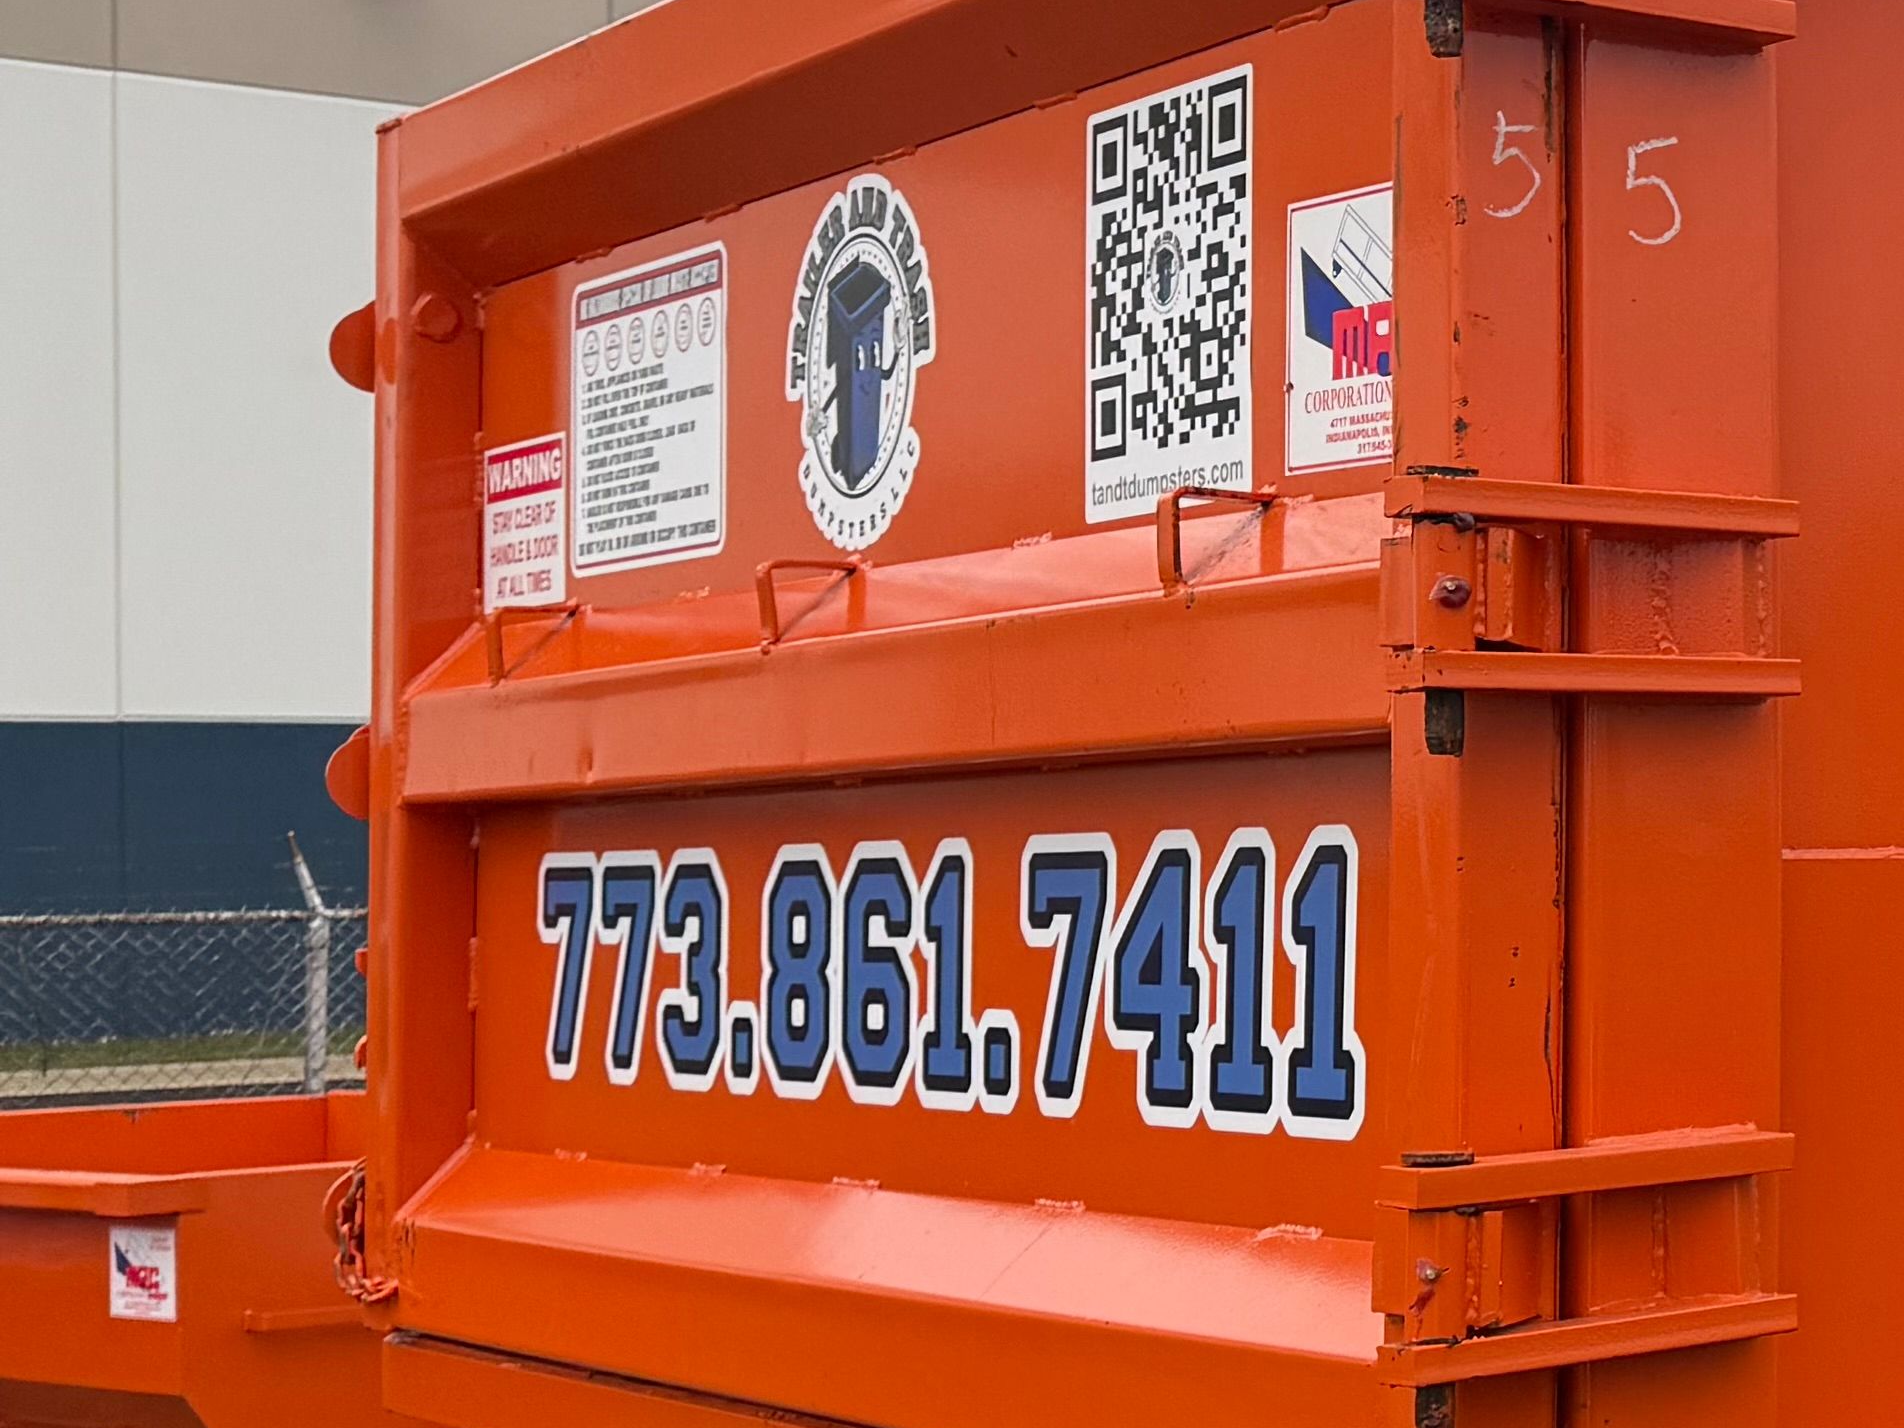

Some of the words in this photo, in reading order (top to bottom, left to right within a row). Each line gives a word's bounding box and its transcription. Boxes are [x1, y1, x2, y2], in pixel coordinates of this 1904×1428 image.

[1483, 110, 1541, 218] 5
[1626, 136, 1682, 245] 5
[790, 205, 845, 389] TRAILER
[848, 186, 888, 232] AND
[888, 203, 930, 355] TRASH
[1332, 300, 1393, 380] MA
[1304, 379, 1393, 414] CORPORATION
[1349, 411, 1393, 425] MASSACHU
[488, 448, 562, 494] WARNING
[1092, 459, 1244, 507] tandtdumpsters.com
[541, 843, 1356, 1118] 773.861.7411
